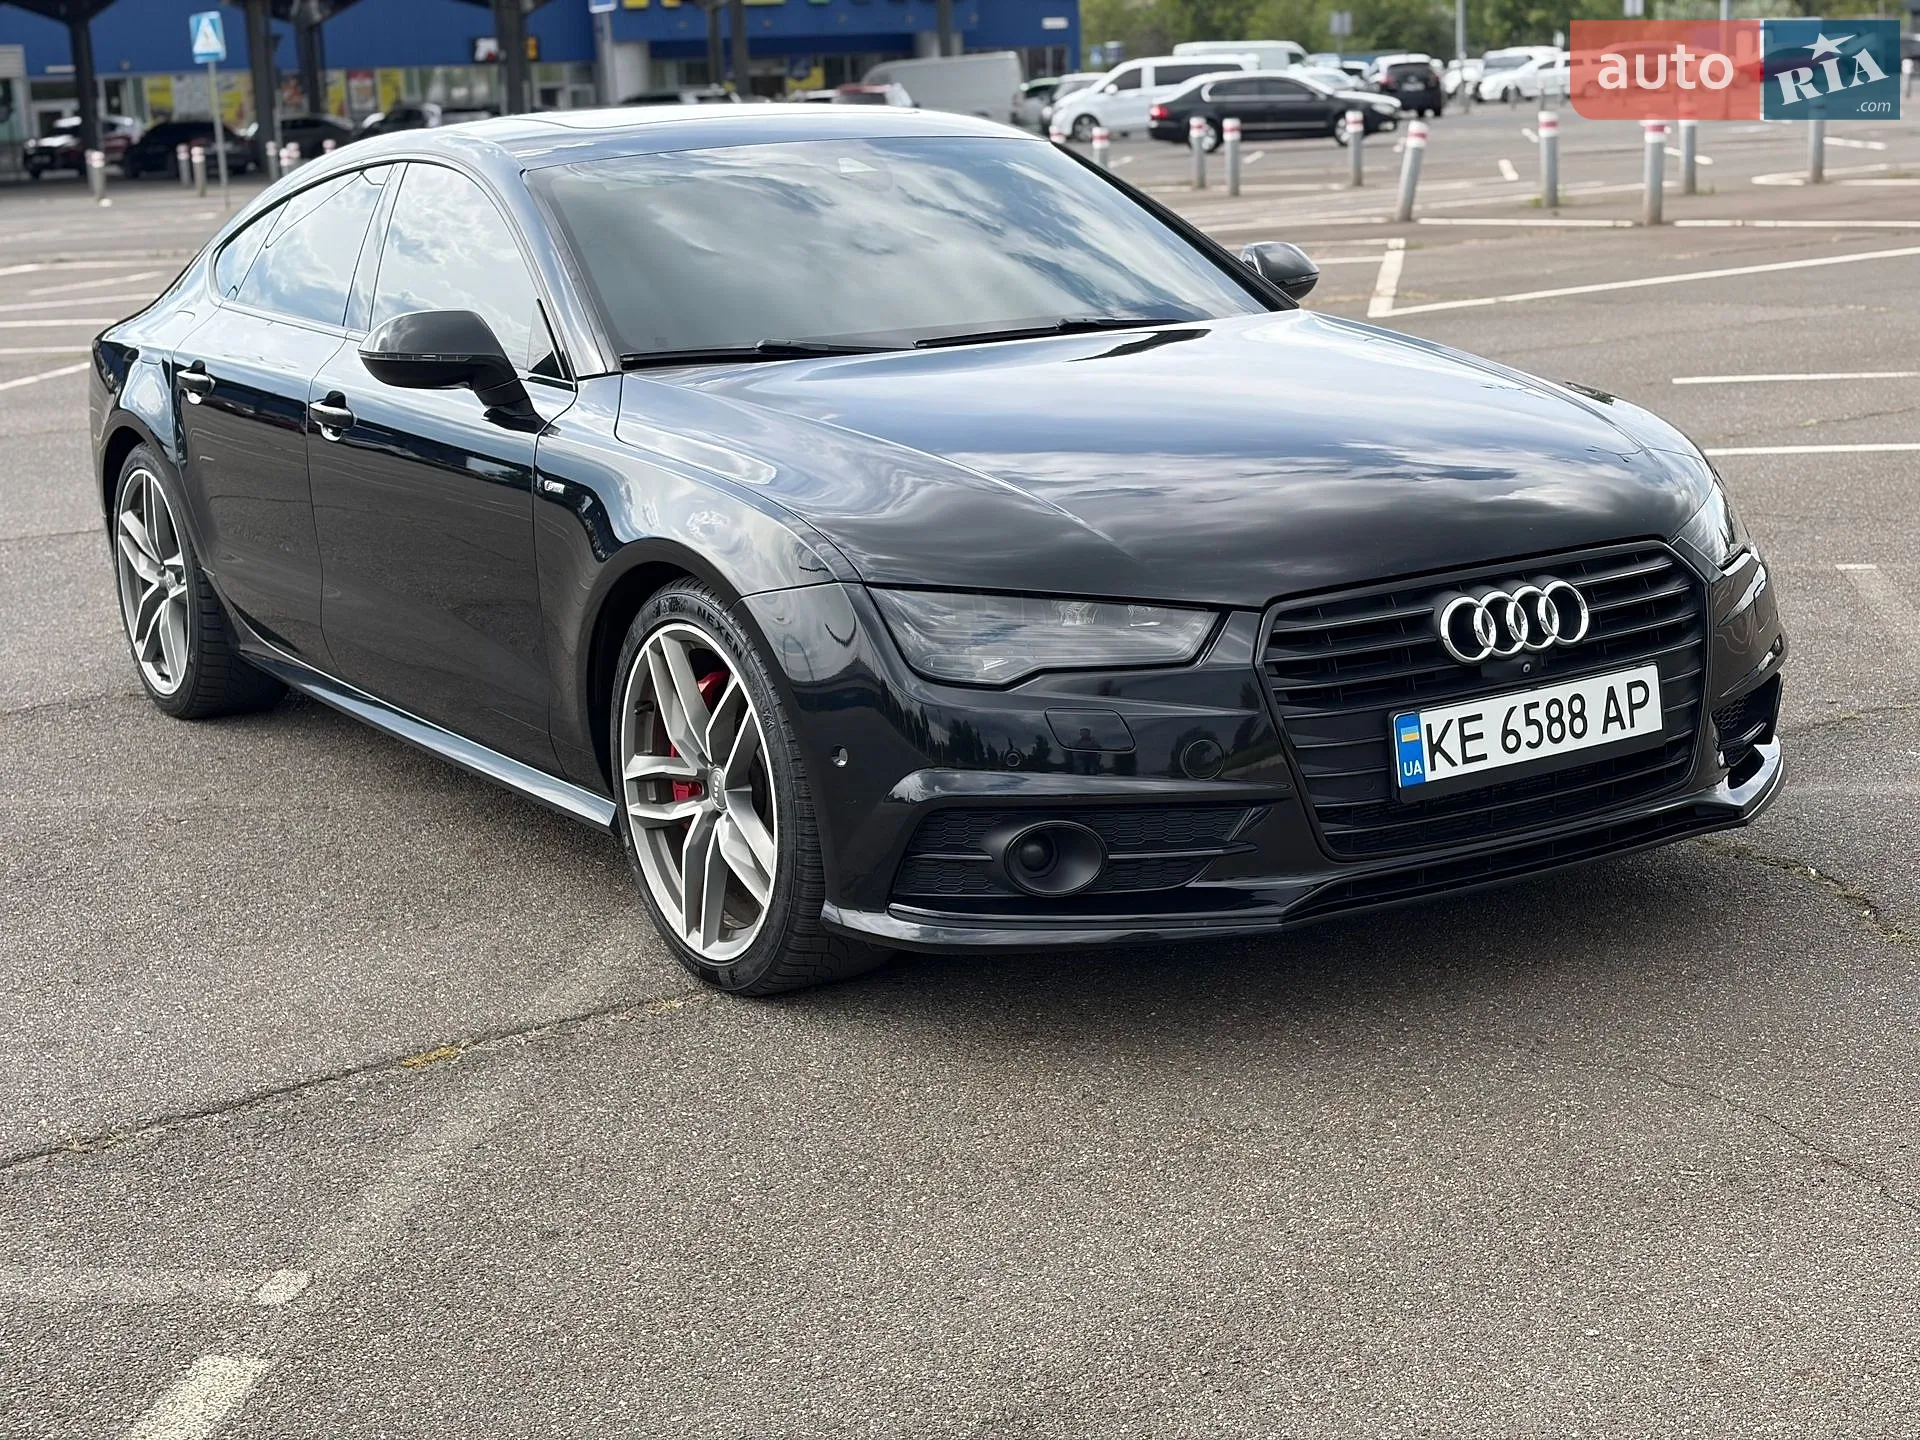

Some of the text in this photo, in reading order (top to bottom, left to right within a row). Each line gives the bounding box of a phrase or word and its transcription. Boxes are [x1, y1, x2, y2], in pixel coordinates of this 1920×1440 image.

[696, 605, 743, 659] NEXEN
[1425, 679, 1650, 772] KE 6588 AP
[1403, 760, 1423, 777] UA
